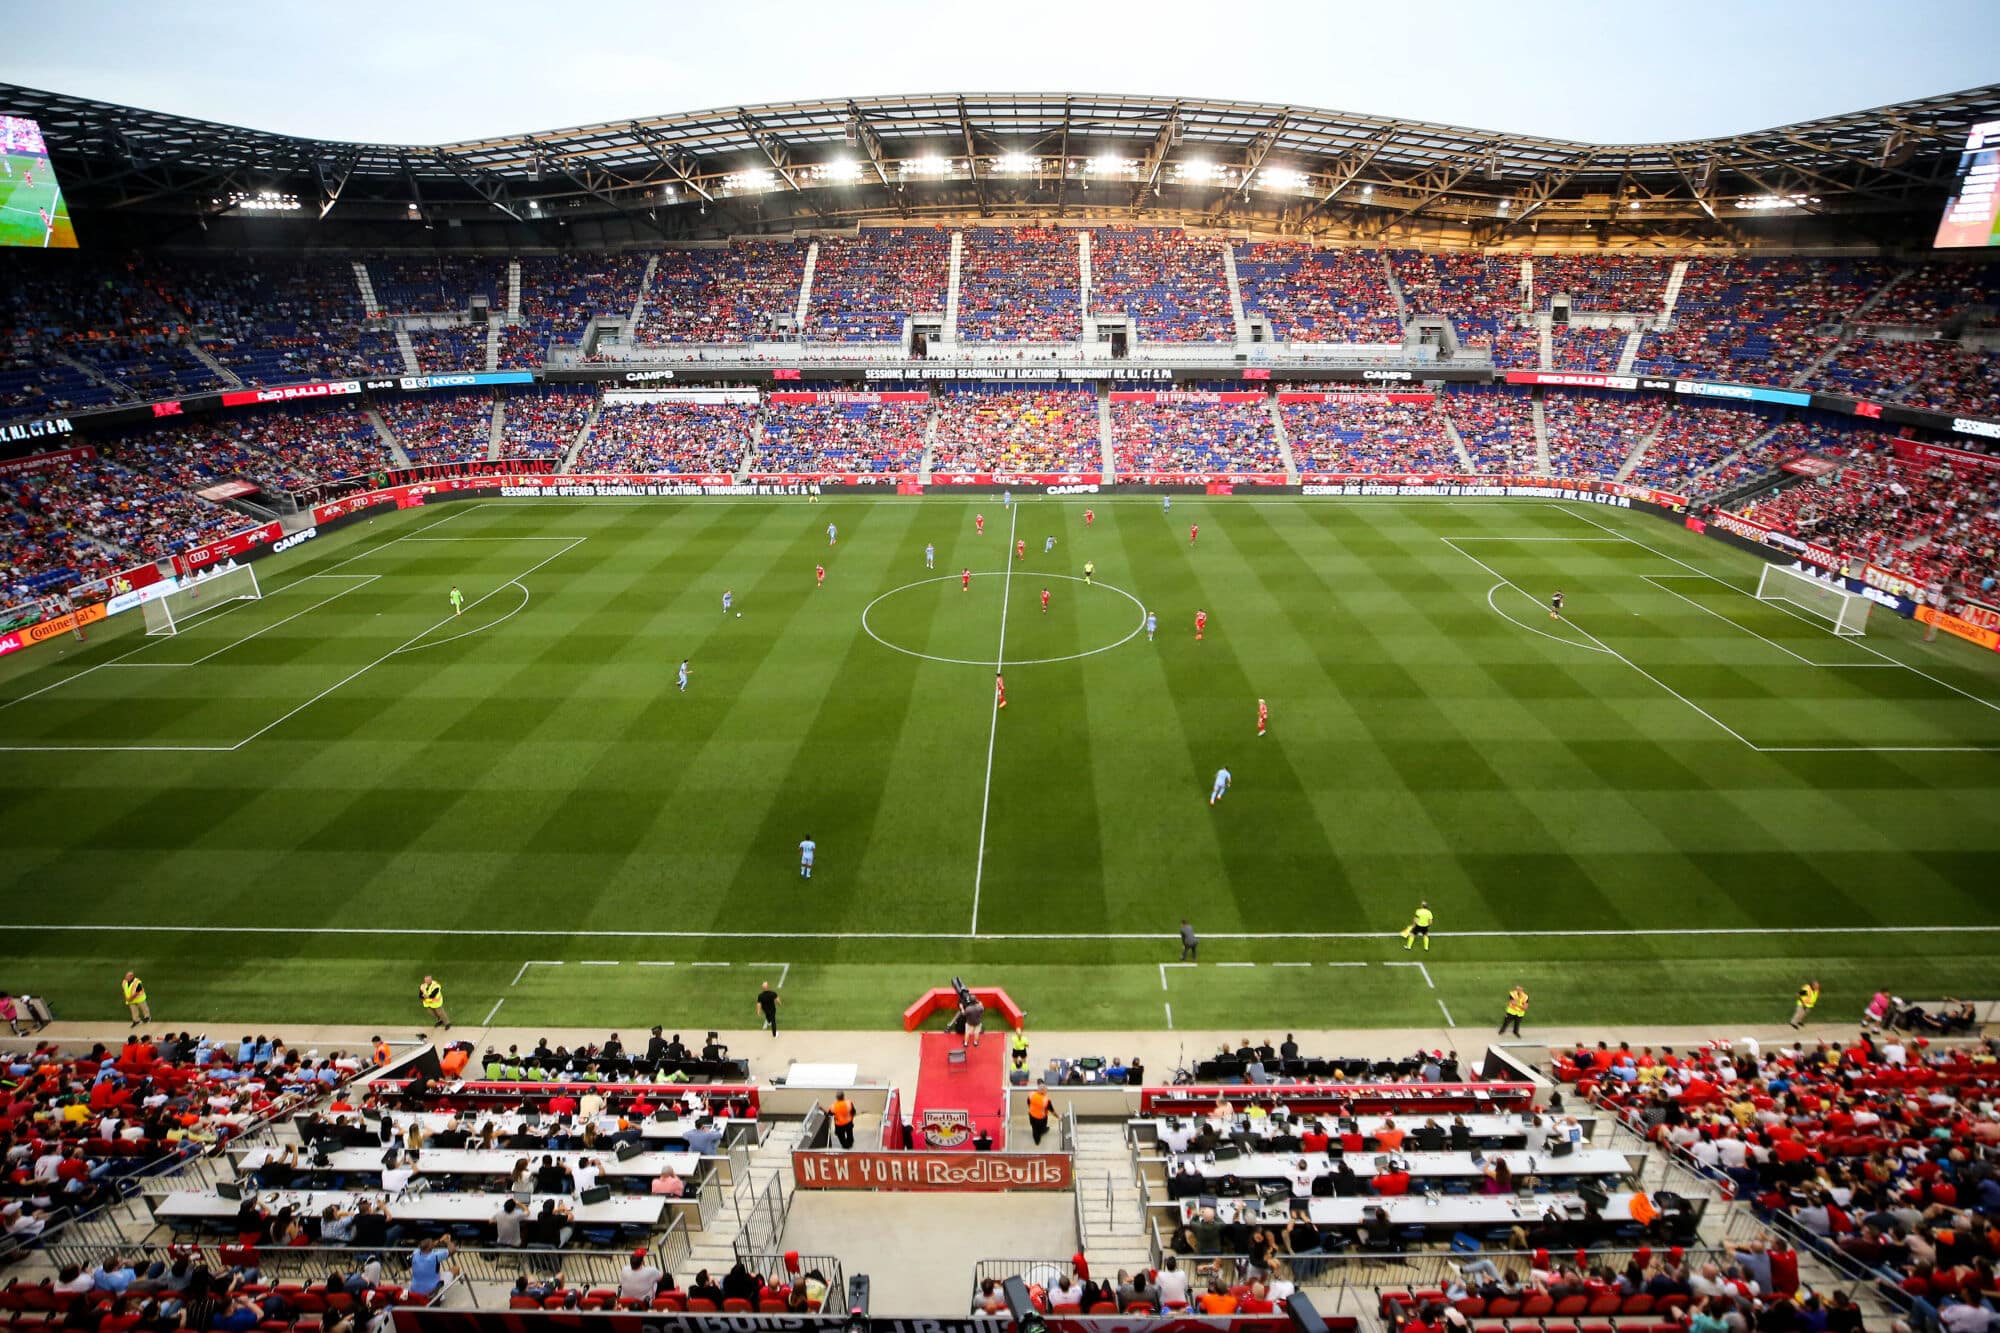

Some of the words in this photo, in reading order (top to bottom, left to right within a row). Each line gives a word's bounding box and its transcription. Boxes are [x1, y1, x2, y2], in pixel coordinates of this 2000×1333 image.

[626, 370, 674, 381] CAMPS
[865, 369, 903, 379] SESSIONS
[905, 369, 920, 379] ARE
[922, 369, 956, 379] OFFERED
[958, 369, 1005, 379] SEASONALLY
[1006, 369, 1016, 379] IN
[1017, 369, 1059, 379] LOCATIONS
[1061, 369, 1112, 379] THROUGHOUT
[1141, 369, 1151, 379] CT
[1154, 369, 1161, 379] &
[1162, 369, 1172, 379] PA
[1363, 371, 1412, 380] CAMPS
[257, 390, 284, 401] RED
[284, 386, 328, 398] BULLS
[0, 427, 10, 442] Y,
[30, 421, 44, 437] CT
[46, 421, 57, 434] &
[56, 418, 73, 433] PA
[501, 486, 540, 496] SESSIONS
[542, 486, 559, 496] ARE
[560, 486, 595, 496] OFFERED
[596, 486, 646, 496] SEASONALLY
[648, 486, 657, 496] IN
[658, 486, 702, 496] LOCATIONS
[704, 486, 757, 496] THROUGHOUT
[760, 486, 772, 496] NY,
[774, 486, 787, 496] NJ,
[788, 486, 799, 496] CT
[801, 486, 808, 495] &
[1046, 484, 1099, 494] CAMPS
[1302, 485, 1342, 495] SESSIONS
[1344, 486, 1361, 495] ARE
[1362, 486, 1398, 495] OFFERED
[1398, 486, 1450, 496] SEASONALLY
[1451, 486, 1460, 496] IN
[1462, 486, 1506, 496] LOCATIONS
[1506, 486, 1562, 498] THROUGHOUT
[1595, 494, 1608, 504] CT
[1608, 495, 1616, 506] &
[1618, 496, 1630, 508] PA
[272, 527, 318, 553] CAMPS
[803, 1158, 849, 1181] NEW
[860, 1158, 918, 1181] YORK
